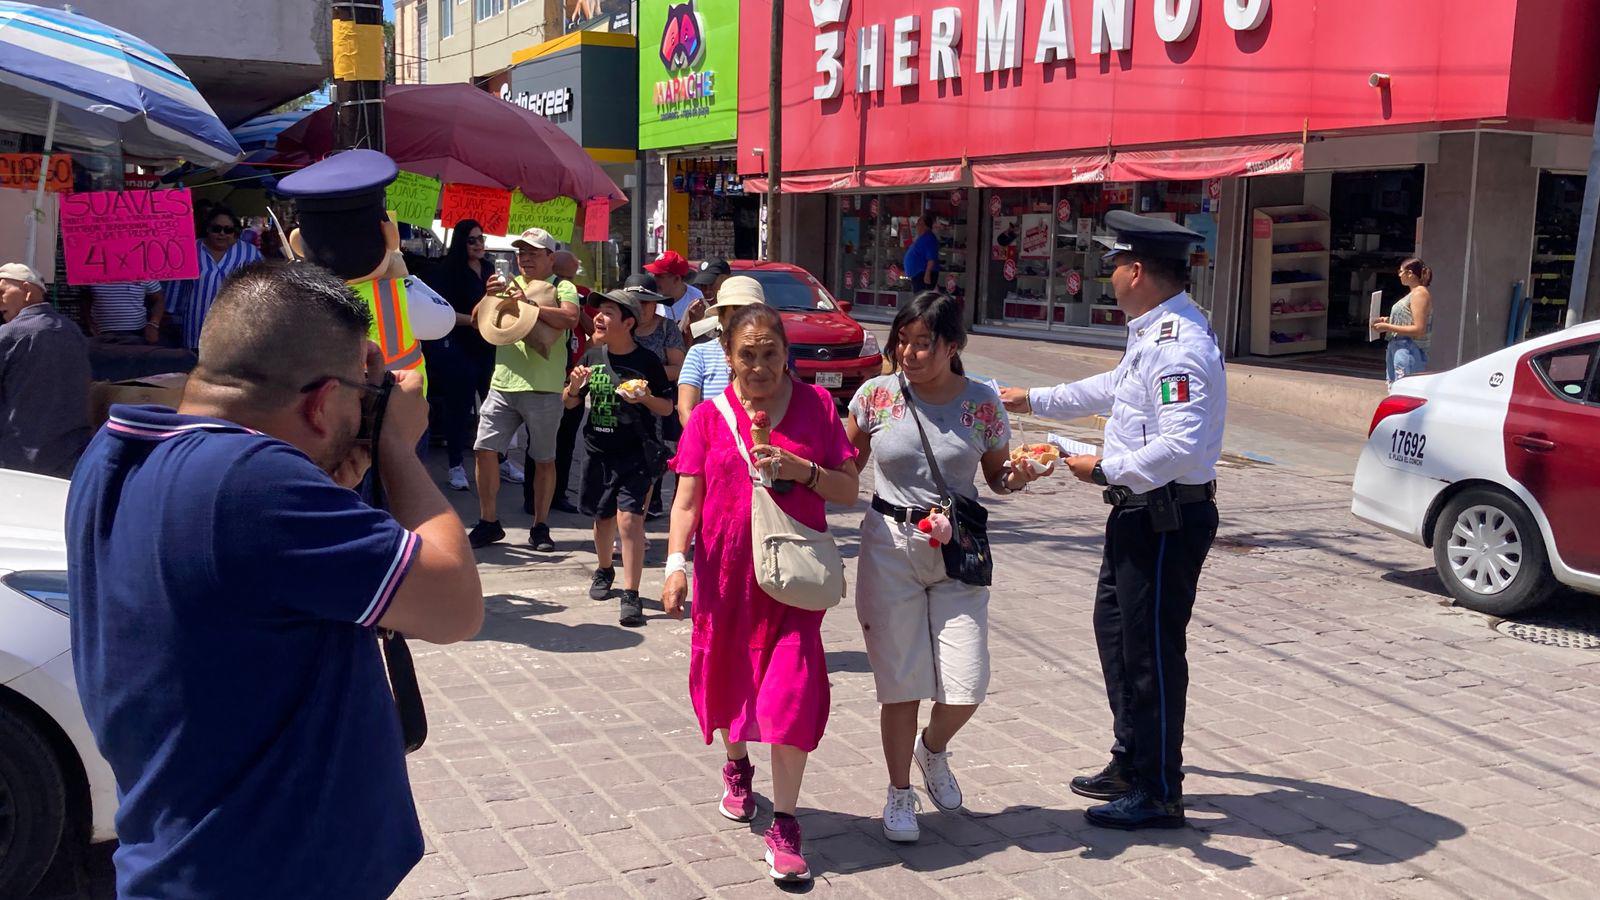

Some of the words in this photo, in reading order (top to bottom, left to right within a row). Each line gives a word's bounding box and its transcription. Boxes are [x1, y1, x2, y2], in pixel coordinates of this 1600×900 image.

[813, 30, 844, 100] 3
[652, 71, 714, 105] MAPACHE
[64, 188, 191, 217] SUAVES
[84, 244, 108, 276] 4
[128, 239, 186, 274] 100
[1392, 429, 1426, 459] 17692
